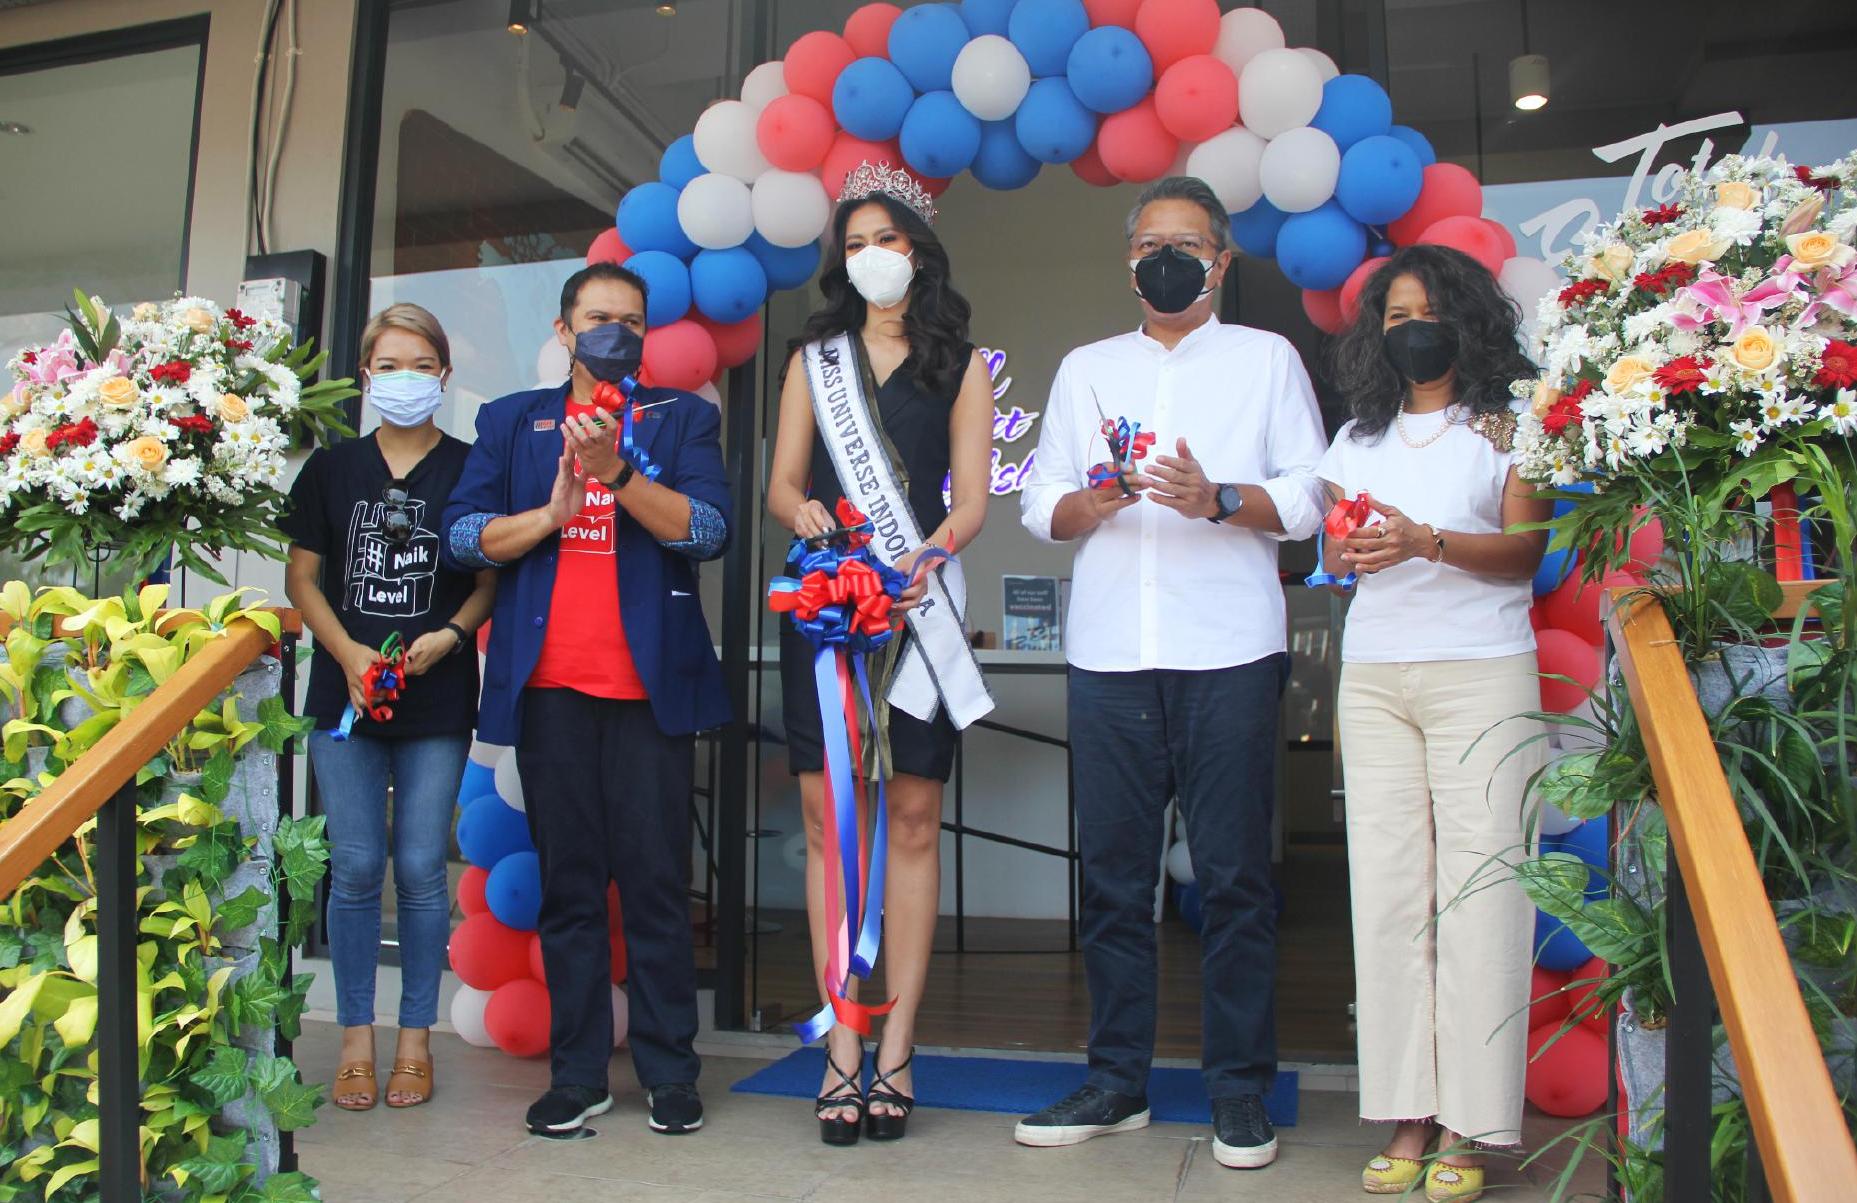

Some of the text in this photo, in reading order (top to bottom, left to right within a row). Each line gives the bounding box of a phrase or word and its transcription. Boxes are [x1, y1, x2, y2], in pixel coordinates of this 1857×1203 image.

[818, 347, 843, 388] MISS
[827, 387, 880, 496] UNIVERSE
[560, 525, 607, 541] Level
[393, 545, 429, 570] Naik
[368, 585, 408, 604] Level
